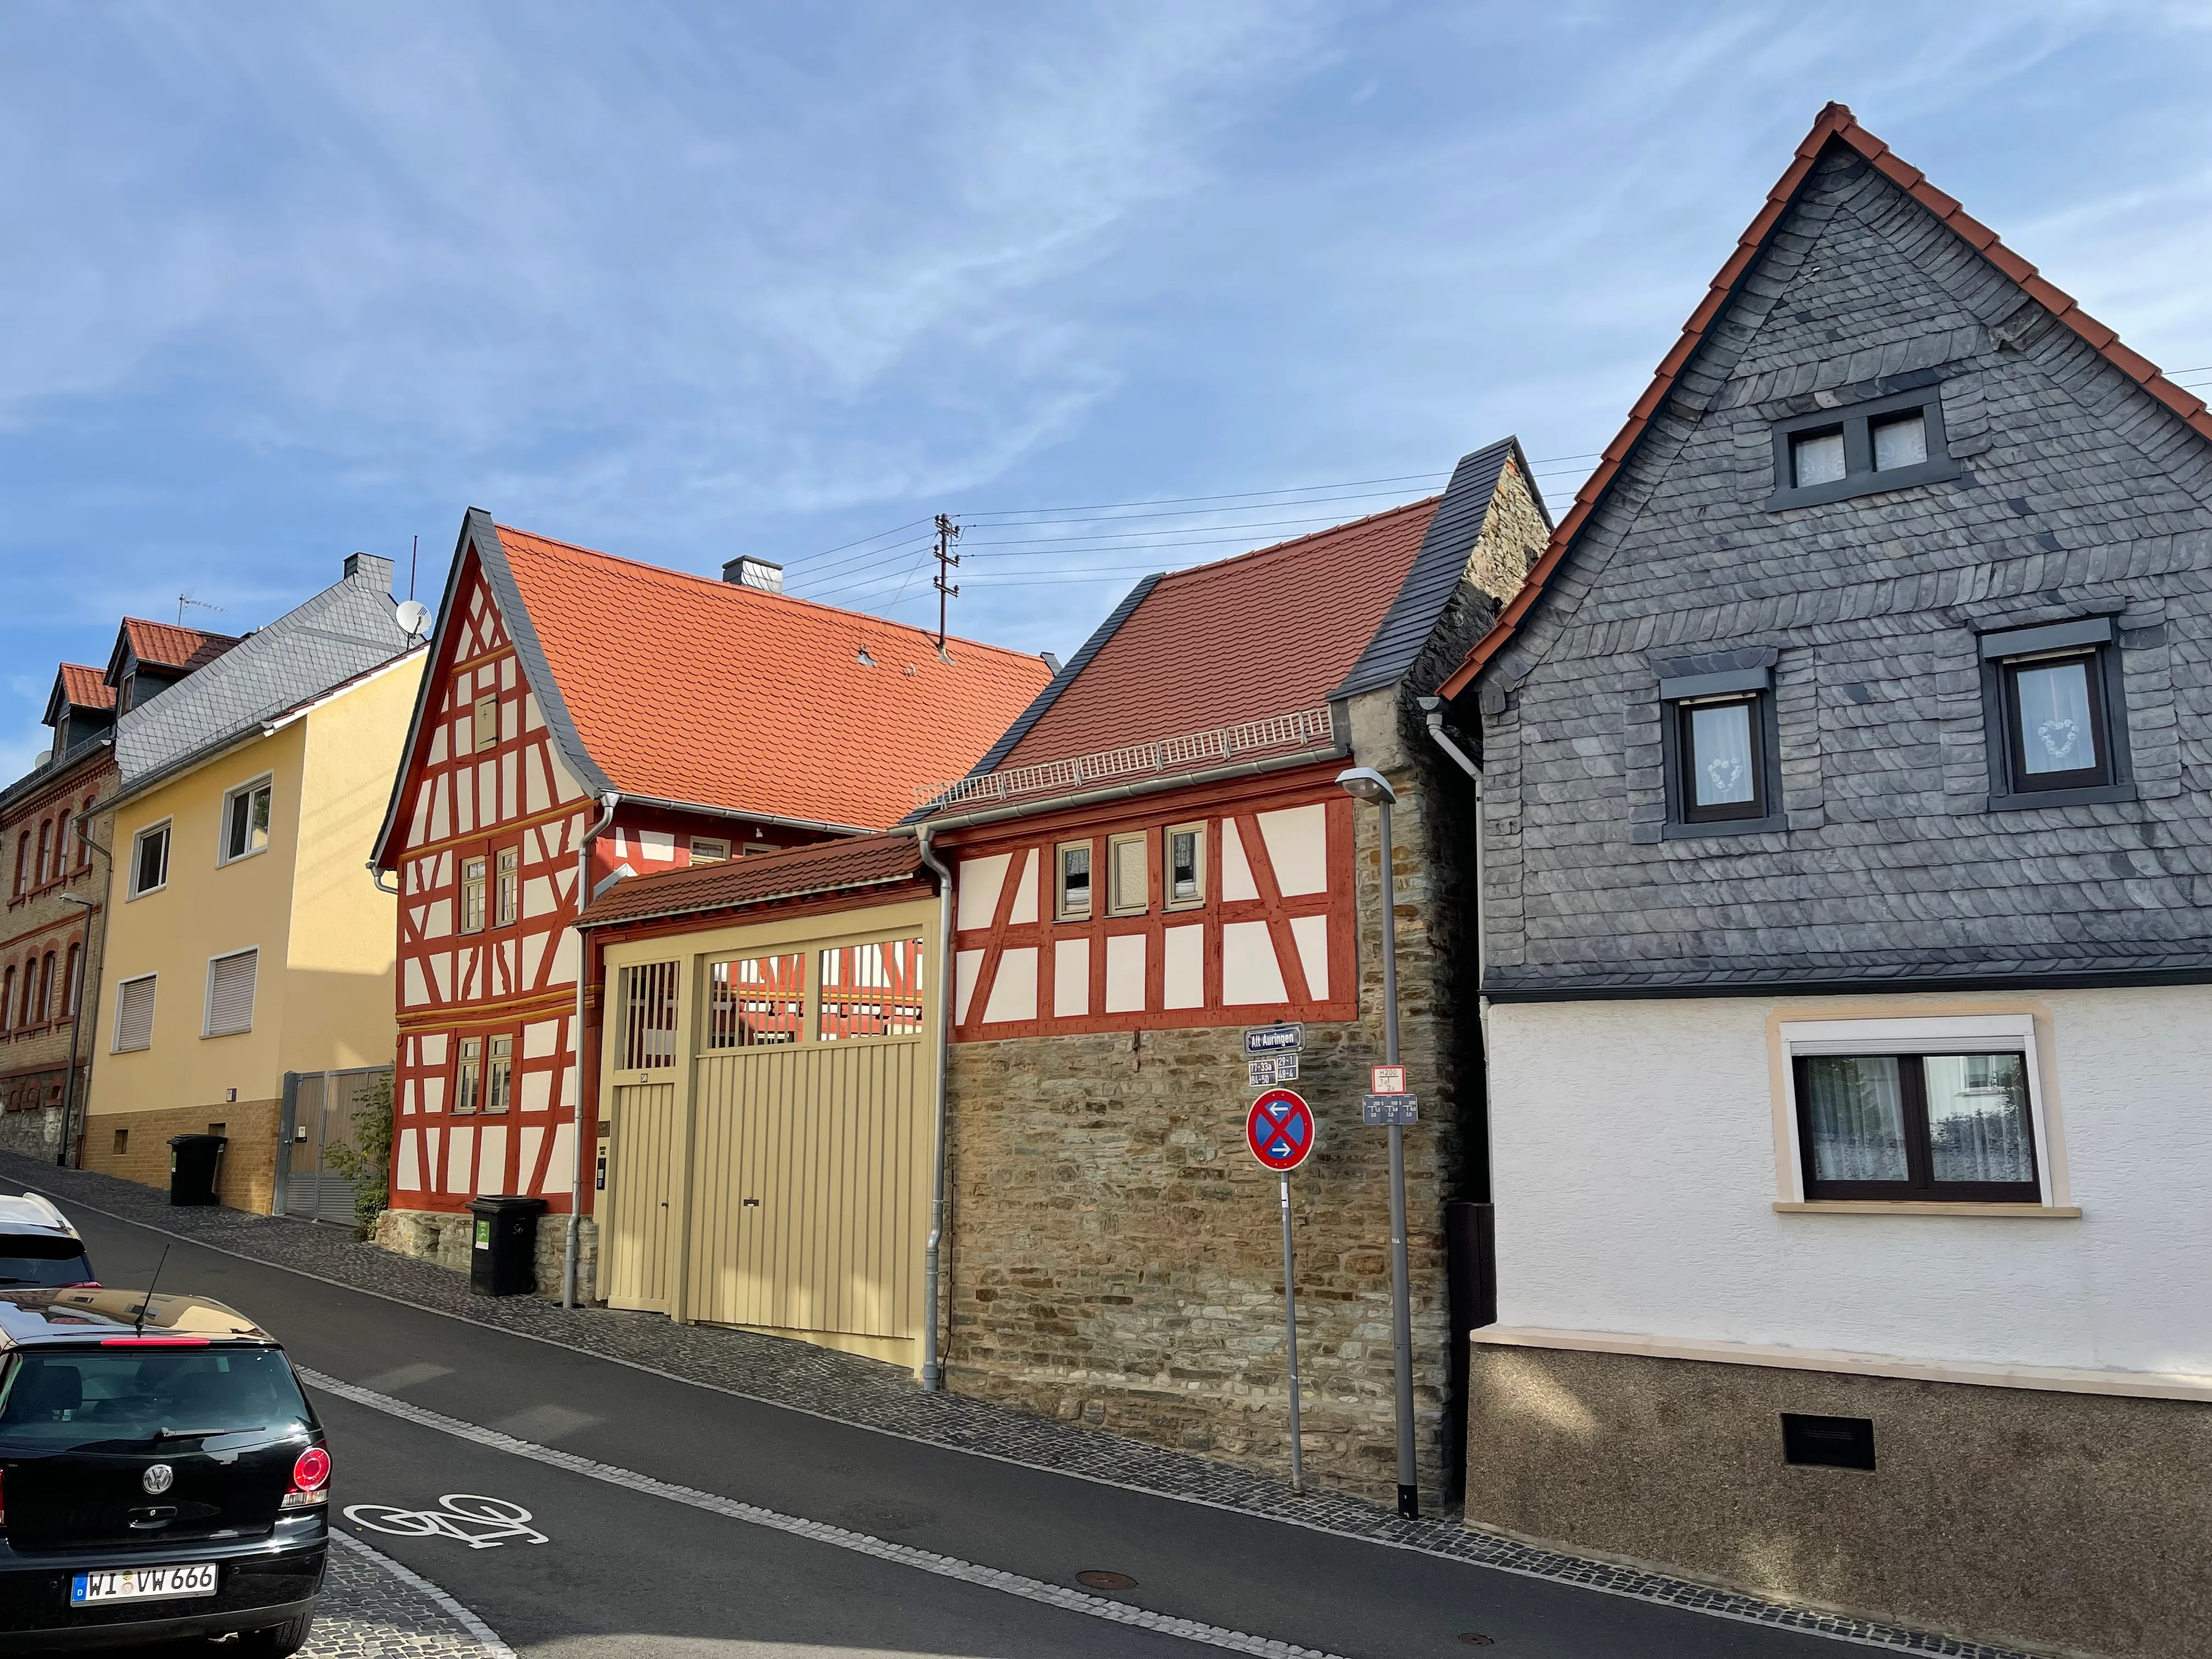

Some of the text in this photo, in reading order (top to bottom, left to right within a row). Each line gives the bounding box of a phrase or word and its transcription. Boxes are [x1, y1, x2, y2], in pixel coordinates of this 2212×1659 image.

[1251, 1032, 1294, 1048] Alt Auringen
[1278, 1056, 1293, 1066] 29-1
[1250, 1062, 1272, 1073] 77-33a
[1251, 1074, 1269, 1085] 84-50
[1278, 1069, 1294, 1079] 48-4
[89, 1572, 117, 1597] WI
[137, 1568, 167, 1592] VW
[171, 1565, 212, 1590] 666
